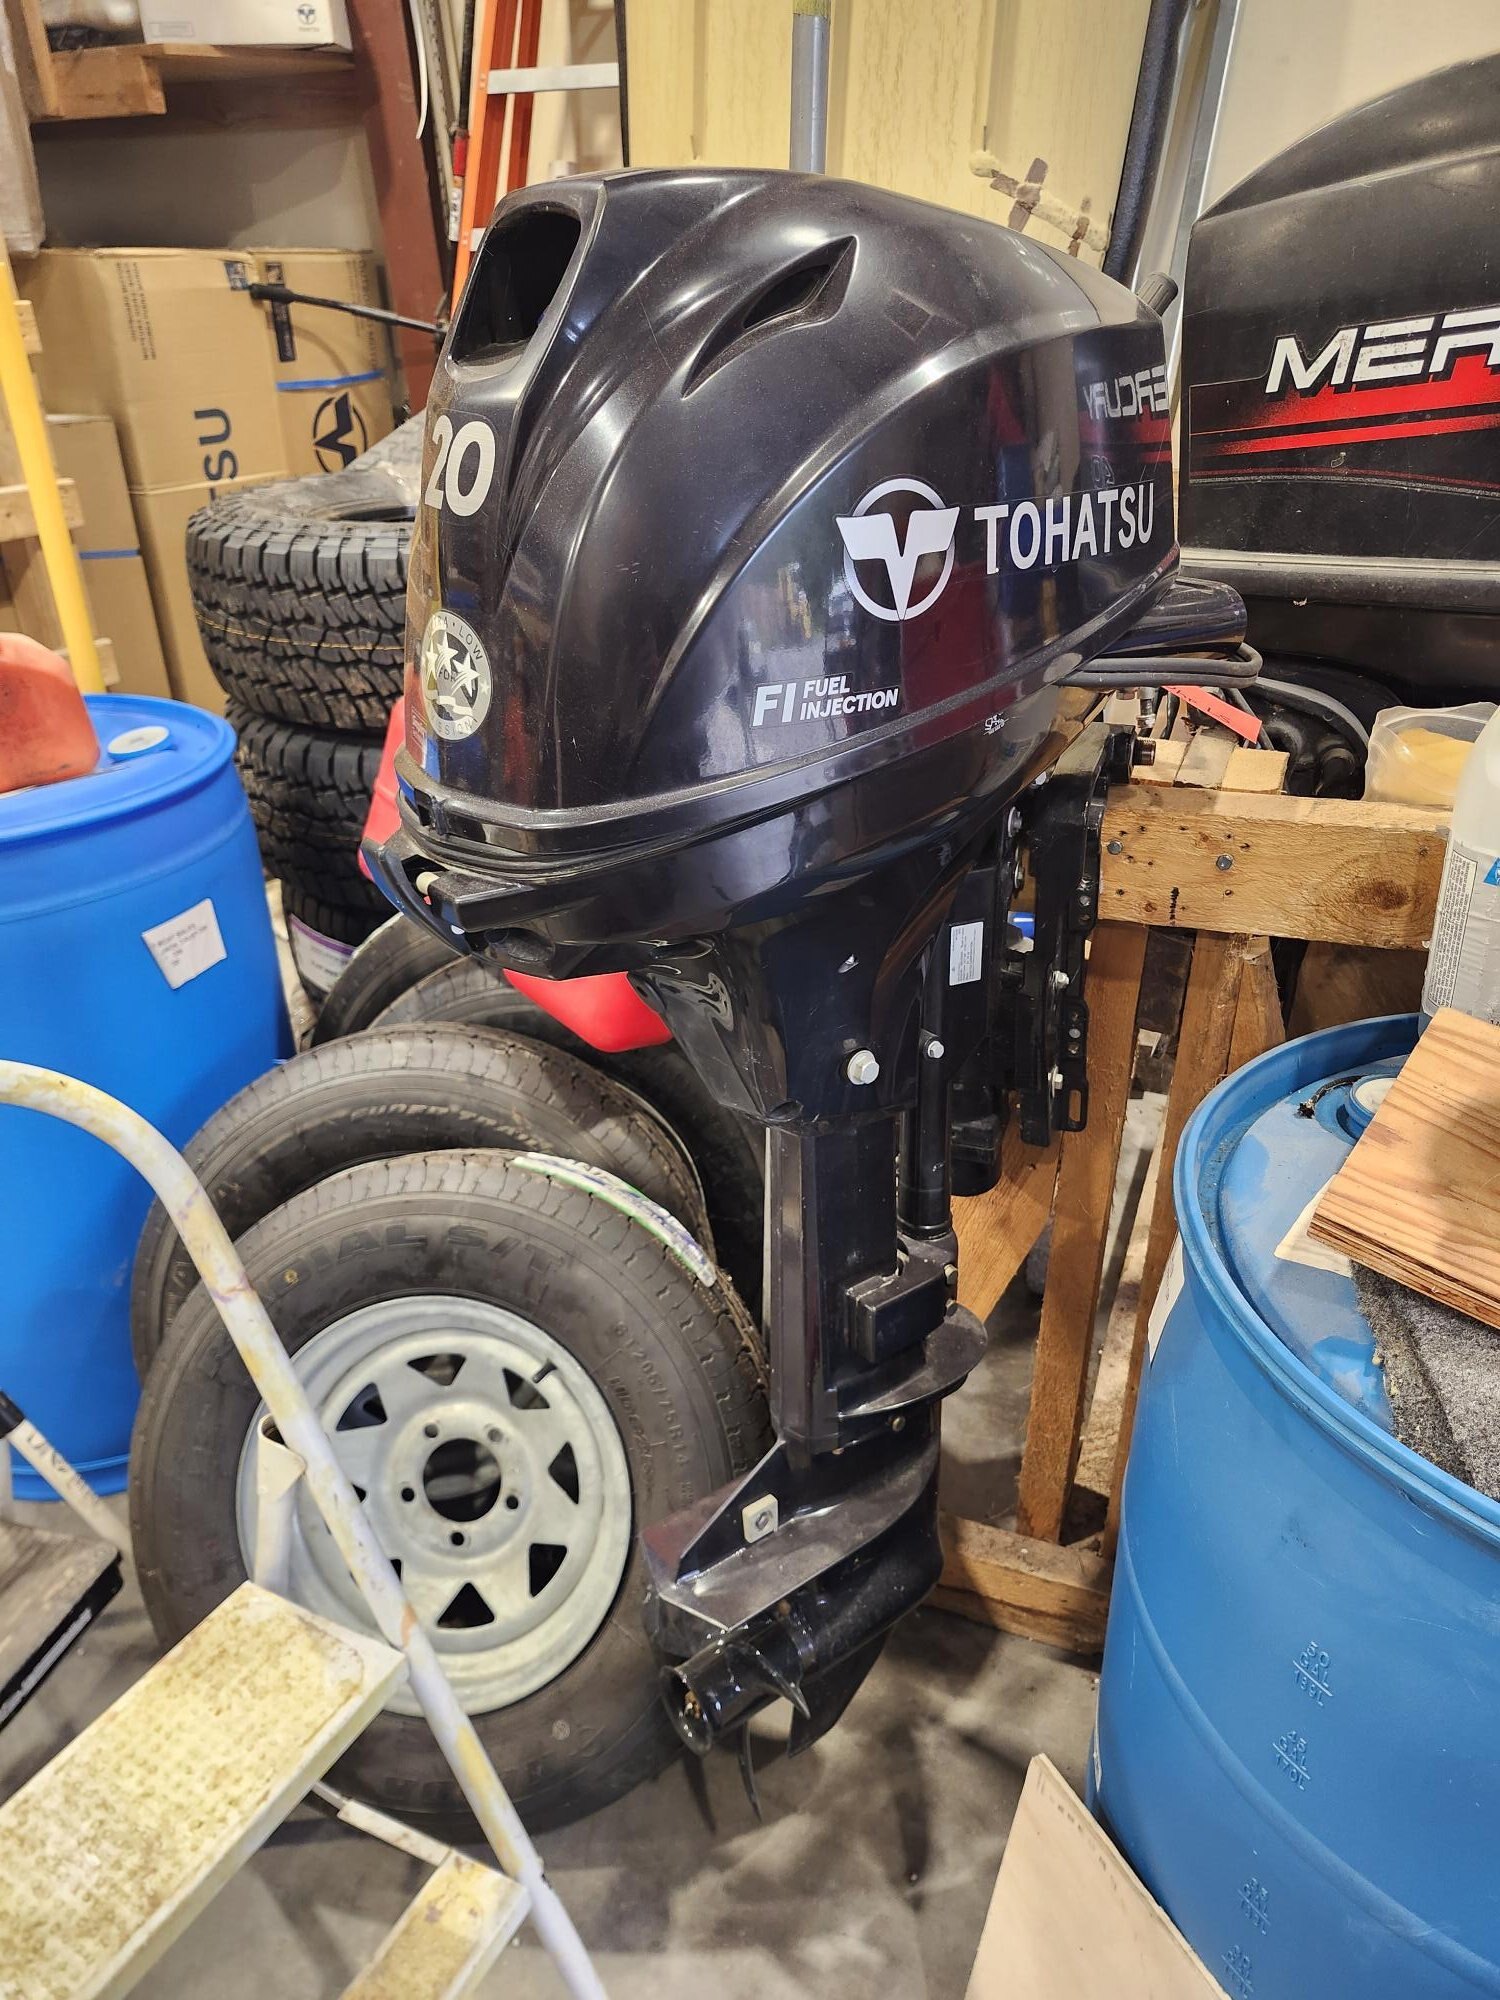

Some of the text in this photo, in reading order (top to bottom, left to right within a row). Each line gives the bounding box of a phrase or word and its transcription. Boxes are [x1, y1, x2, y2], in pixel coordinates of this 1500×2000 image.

[1265, 306, 1500, 394] MER
[424, 414, 496, 516] 20
[973, 483, 1154, 575] TOHATSU
[458, 625, 483, 661] LOW
[752, 683, 797, 727] FI
[800, 689, 899, 721] INJECTION
[803, 676, 850, 699] FUEL
[1299, 1652, 1330, 1688] GAL
[1279, 1736, 1308, 1771] GAL
